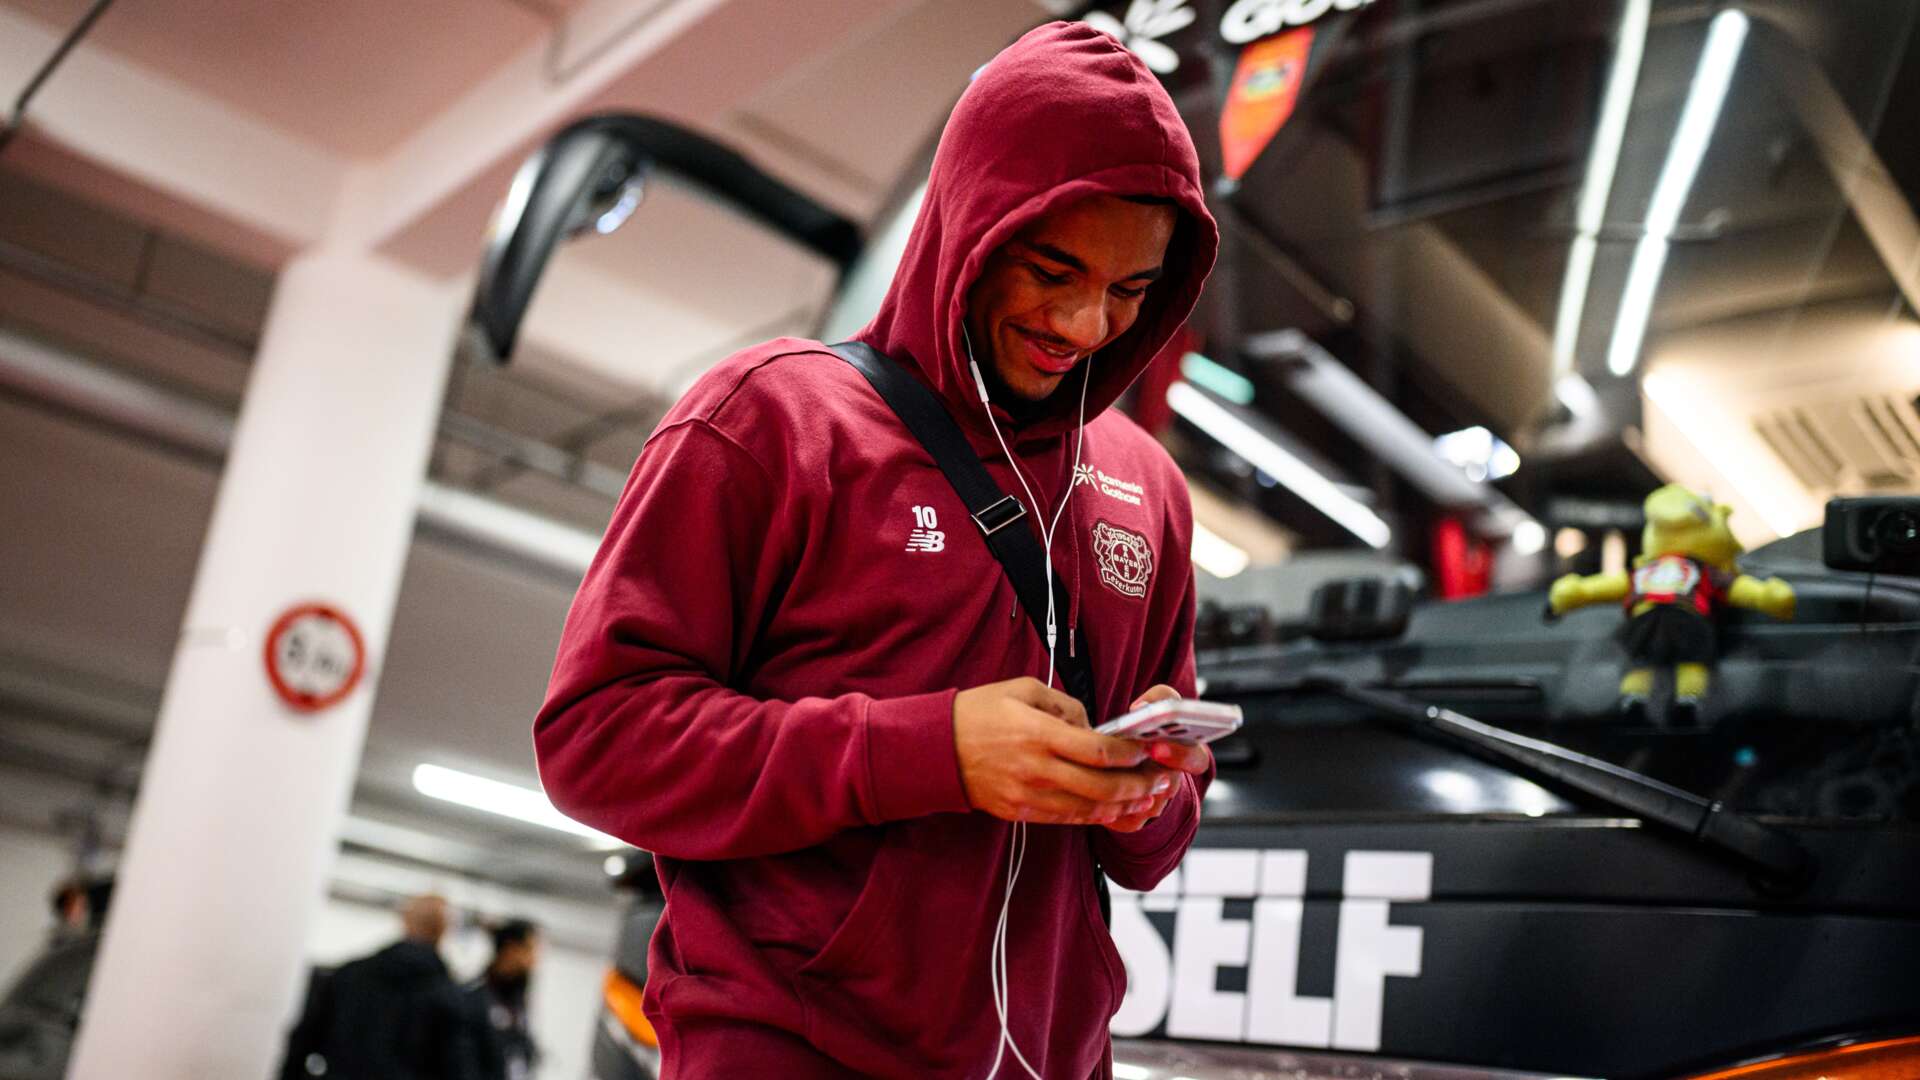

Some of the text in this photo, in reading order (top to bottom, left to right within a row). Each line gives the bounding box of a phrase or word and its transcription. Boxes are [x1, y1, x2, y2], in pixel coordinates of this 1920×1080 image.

[912, 505, 938, 529] 10
[1114, 554, 1138, 568] BAYER
[1106, 847, 1433, 1053] SELF
